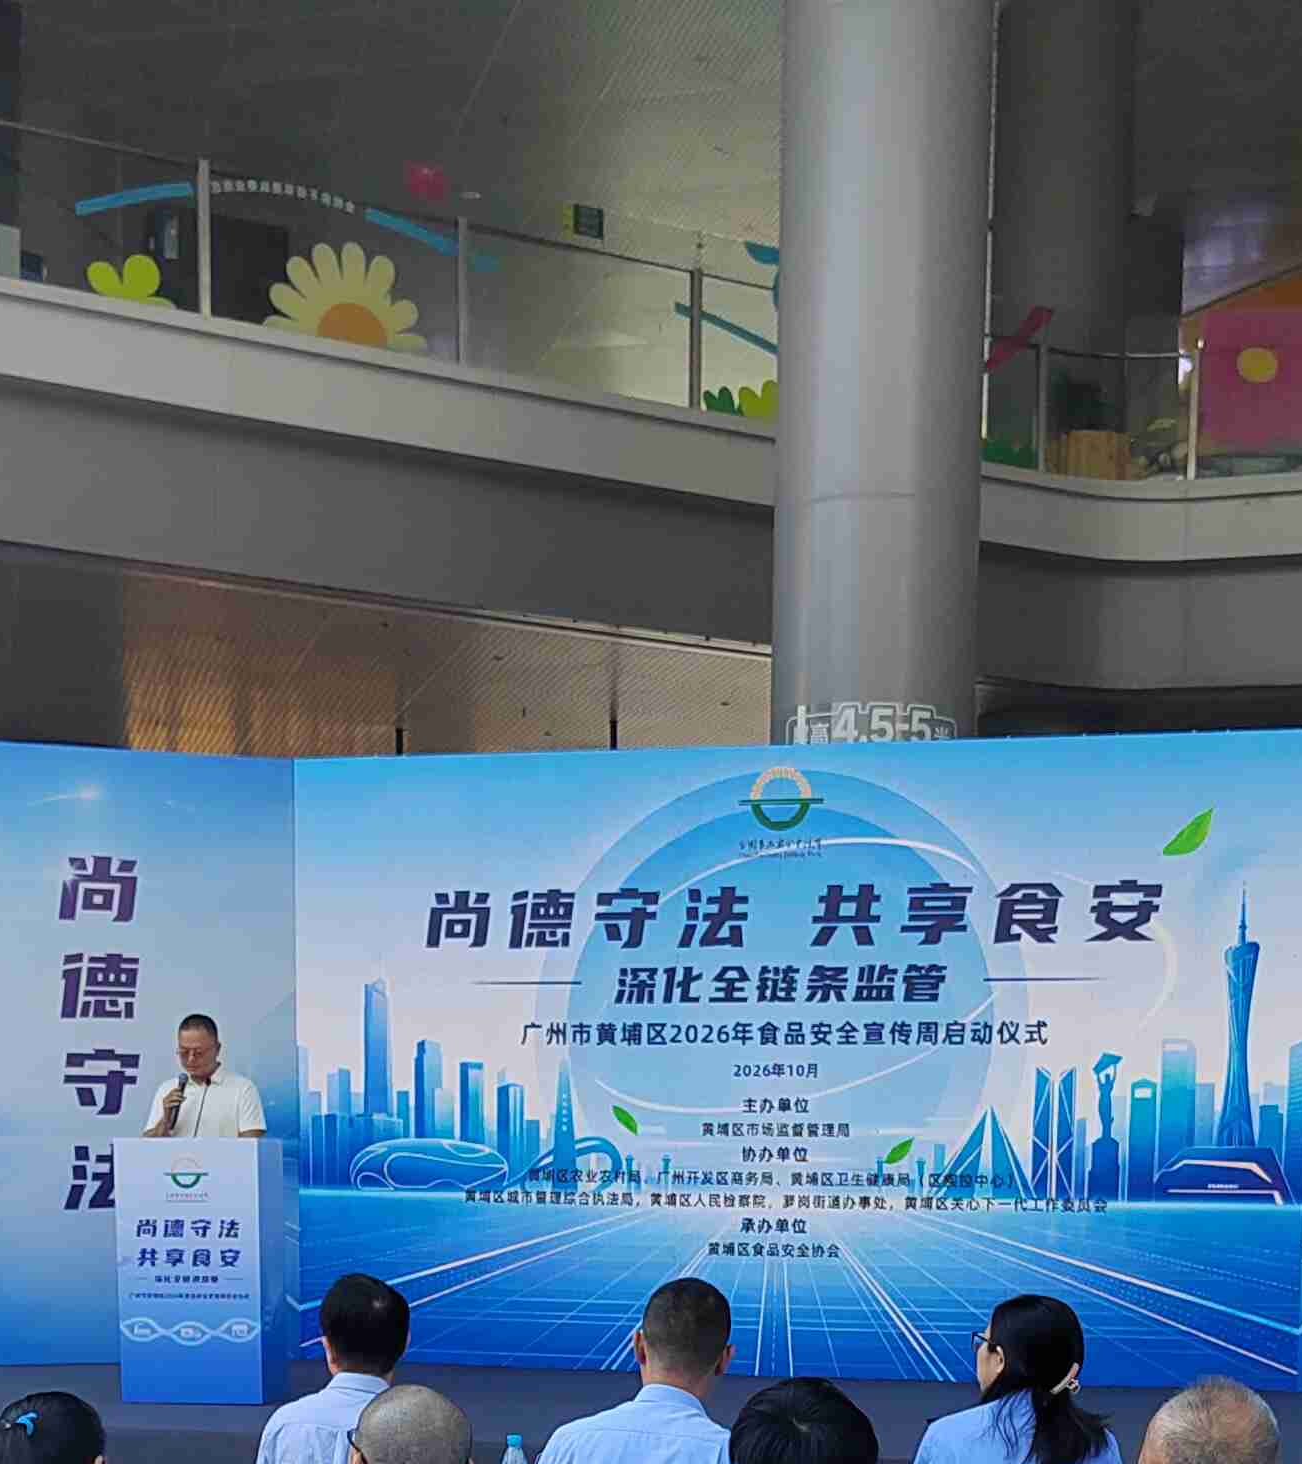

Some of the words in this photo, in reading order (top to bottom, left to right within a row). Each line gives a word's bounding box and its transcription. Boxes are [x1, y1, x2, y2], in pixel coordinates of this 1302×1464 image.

[424, 886, 750, 950] 尚德守法
[810, 879, 1165, 947] 共享食安
[613, 963, 946, 1005] 深化全链条监管
[520, 1020, 1049, 1047] 广州市黄埔区2026年食品安全宣传周启动仪式
[733, 1063, 819, 1079] 2026年10月
[743, 1097, 810, 1114] 主办单位
[702, 1122, 850, 1138] 黄埔区市场监督管理局
[741, 1146, 809, 1163] 协办单位
[136, 1218, 241, 1239] 尚德守法
[740, 1218, 808, 1235] 承办单位
[137, 1248, 241, 1268] 共享食安
[708, 1241, 841, 1259] 黄埔区食品安全协会
